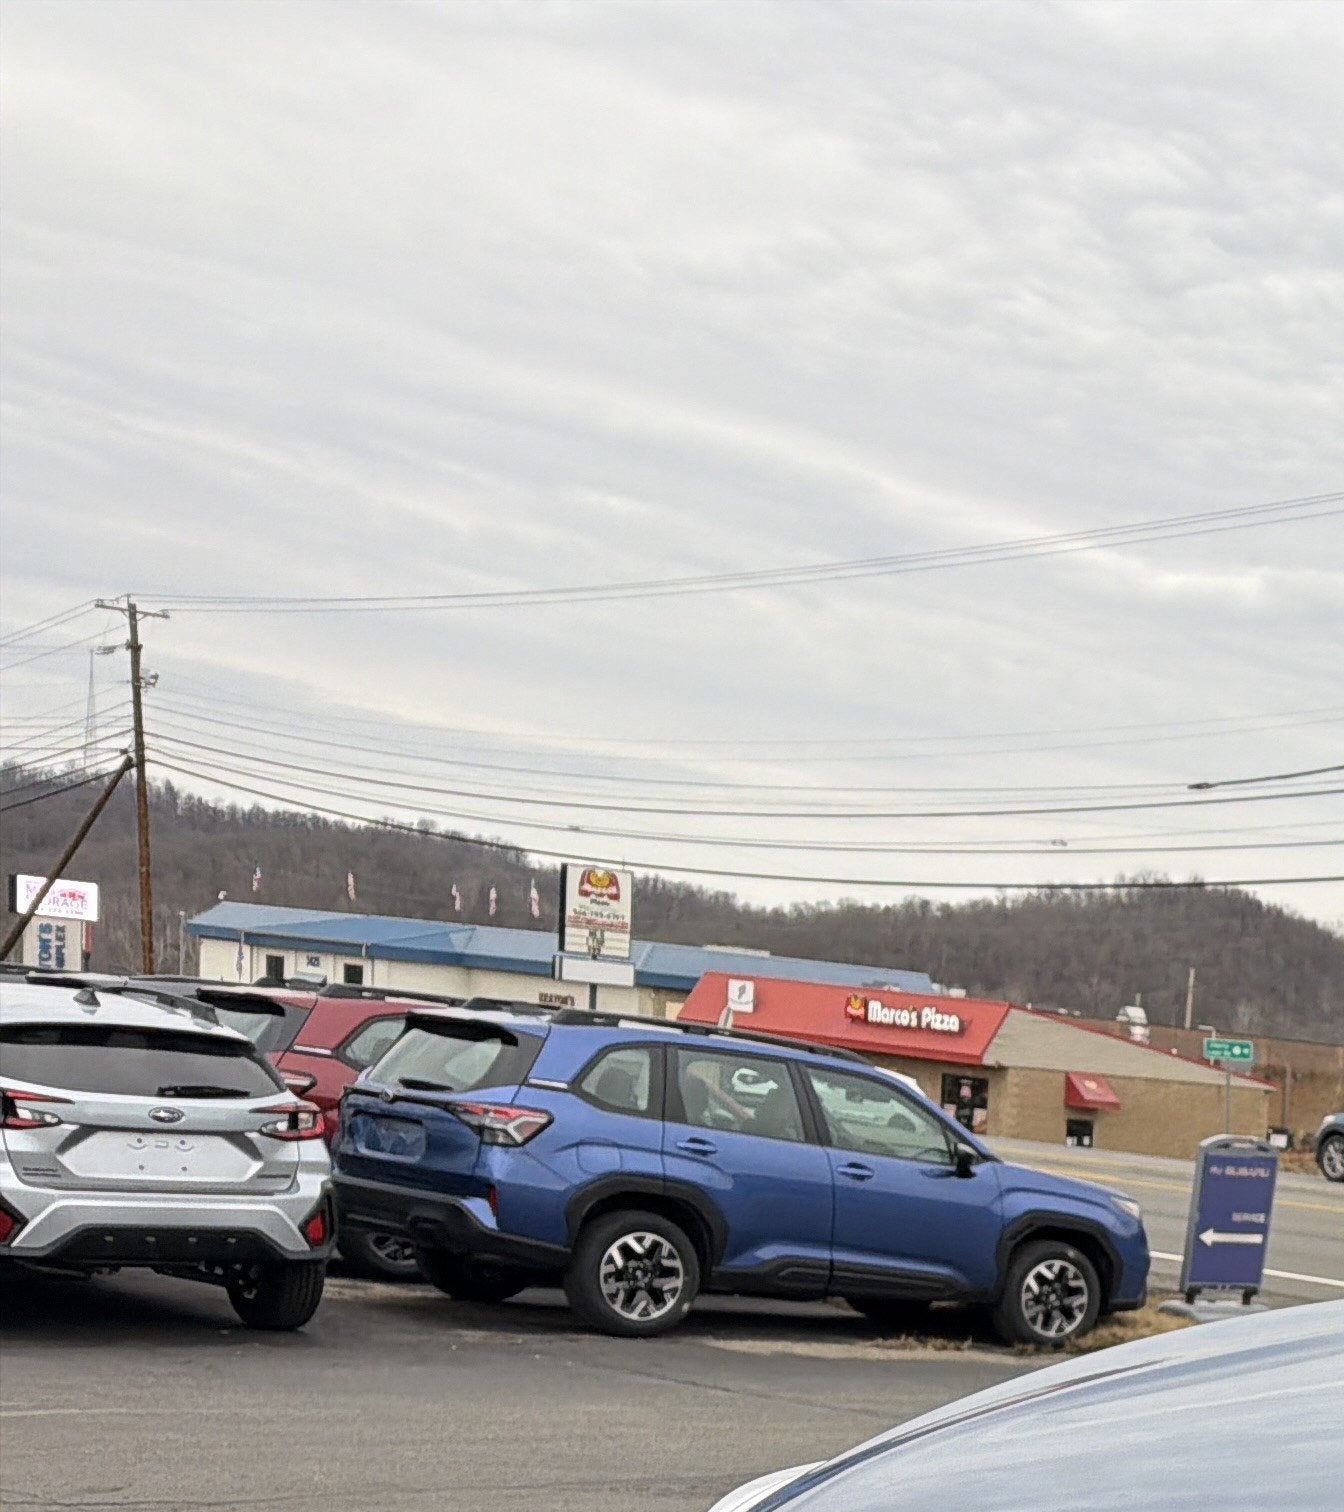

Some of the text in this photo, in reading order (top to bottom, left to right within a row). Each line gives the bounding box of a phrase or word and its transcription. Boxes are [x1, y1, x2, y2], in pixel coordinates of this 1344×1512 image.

[867, 1000, 960, 1032] Marco's Pizza
[1224, 1165, 1270, 1178] SUBARU
